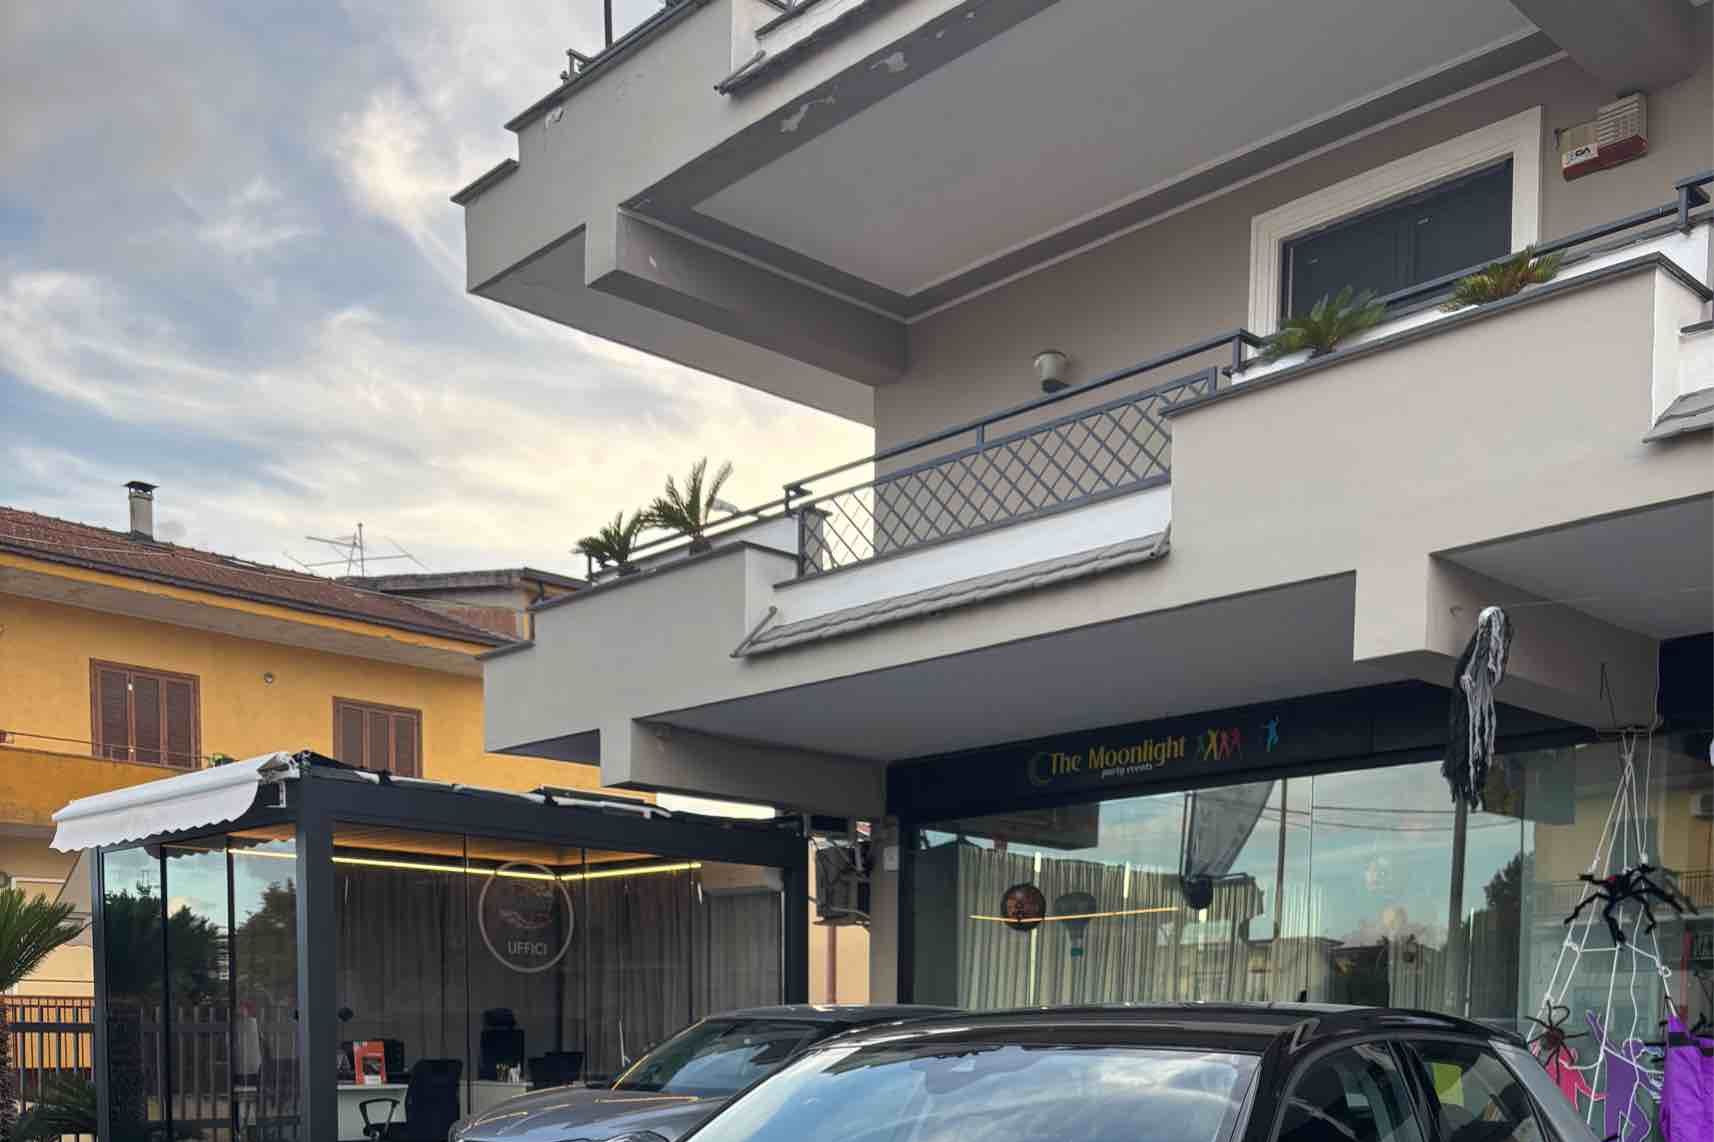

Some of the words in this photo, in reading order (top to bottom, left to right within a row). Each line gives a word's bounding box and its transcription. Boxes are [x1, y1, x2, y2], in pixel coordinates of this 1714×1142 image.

[1051, 752, 1081, 775] The
[1088, 735, 1185, 769] Moonlight
[507, 940, 548, 956] UFFICI
